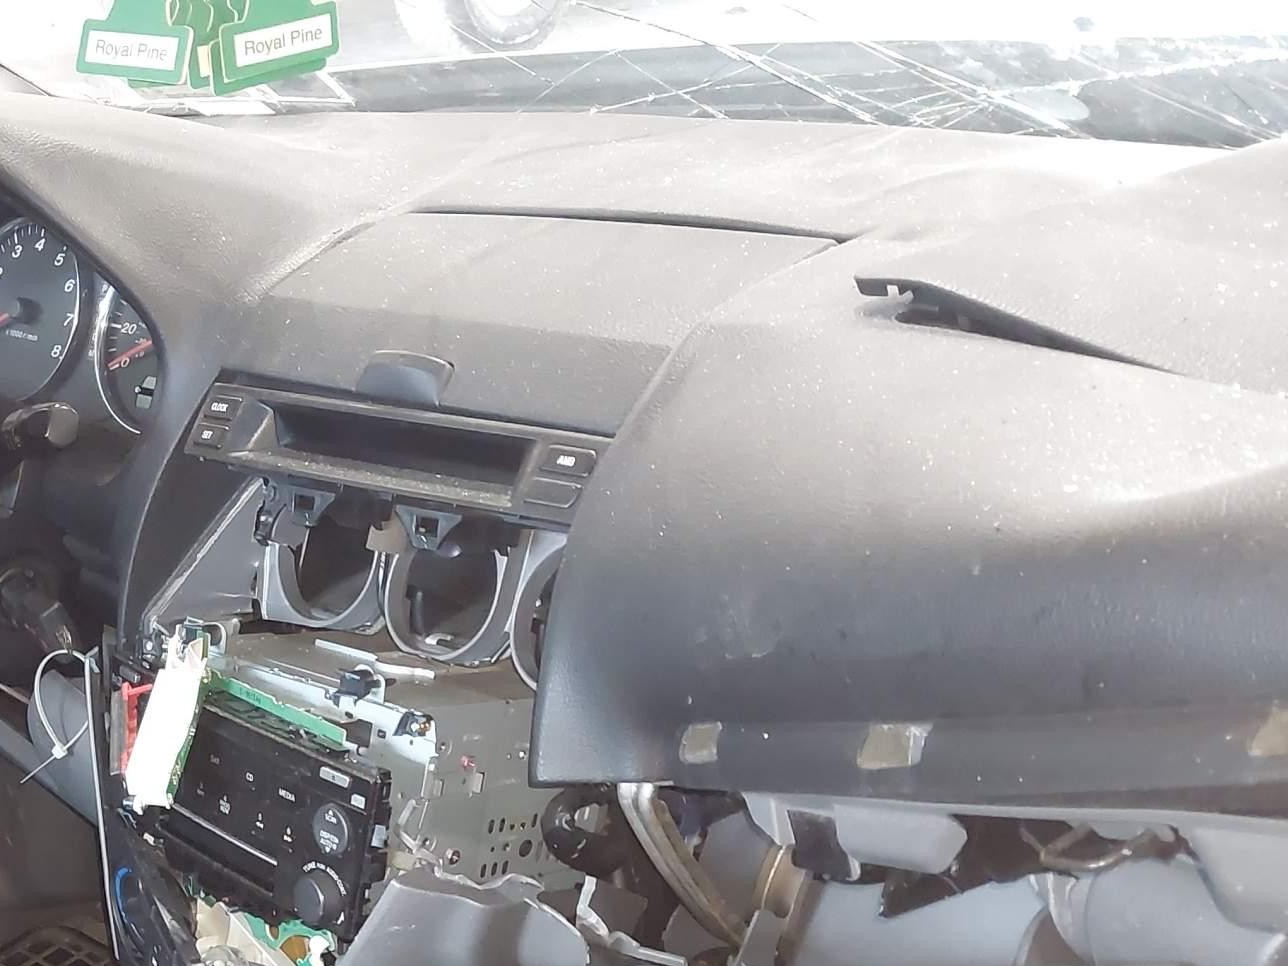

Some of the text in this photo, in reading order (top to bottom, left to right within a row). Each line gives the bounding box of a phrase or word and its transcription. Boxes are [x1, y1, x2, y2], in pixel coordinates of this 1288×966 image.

[244, 26, 323, 57] Royal Pine
[95, 39, 168, 62] Royal Pine
[35, 238, 46, 251] 4
[12, 245, 23, 258] 3
[54, 253, 65, 266] 5
[64, 279, 75, 292] 6
[63, 313, 73, 326] 7
[120, 322, 137, 335] 20
[51, 345, 62, 358] 8
[120, 357, 130, 368] 0
[202, 430, 213, 439] SET
[556, 455, 576, 467] AMB
[246, 772, 253, 782] CD
[278, 787, 295, 802] MEDIA
